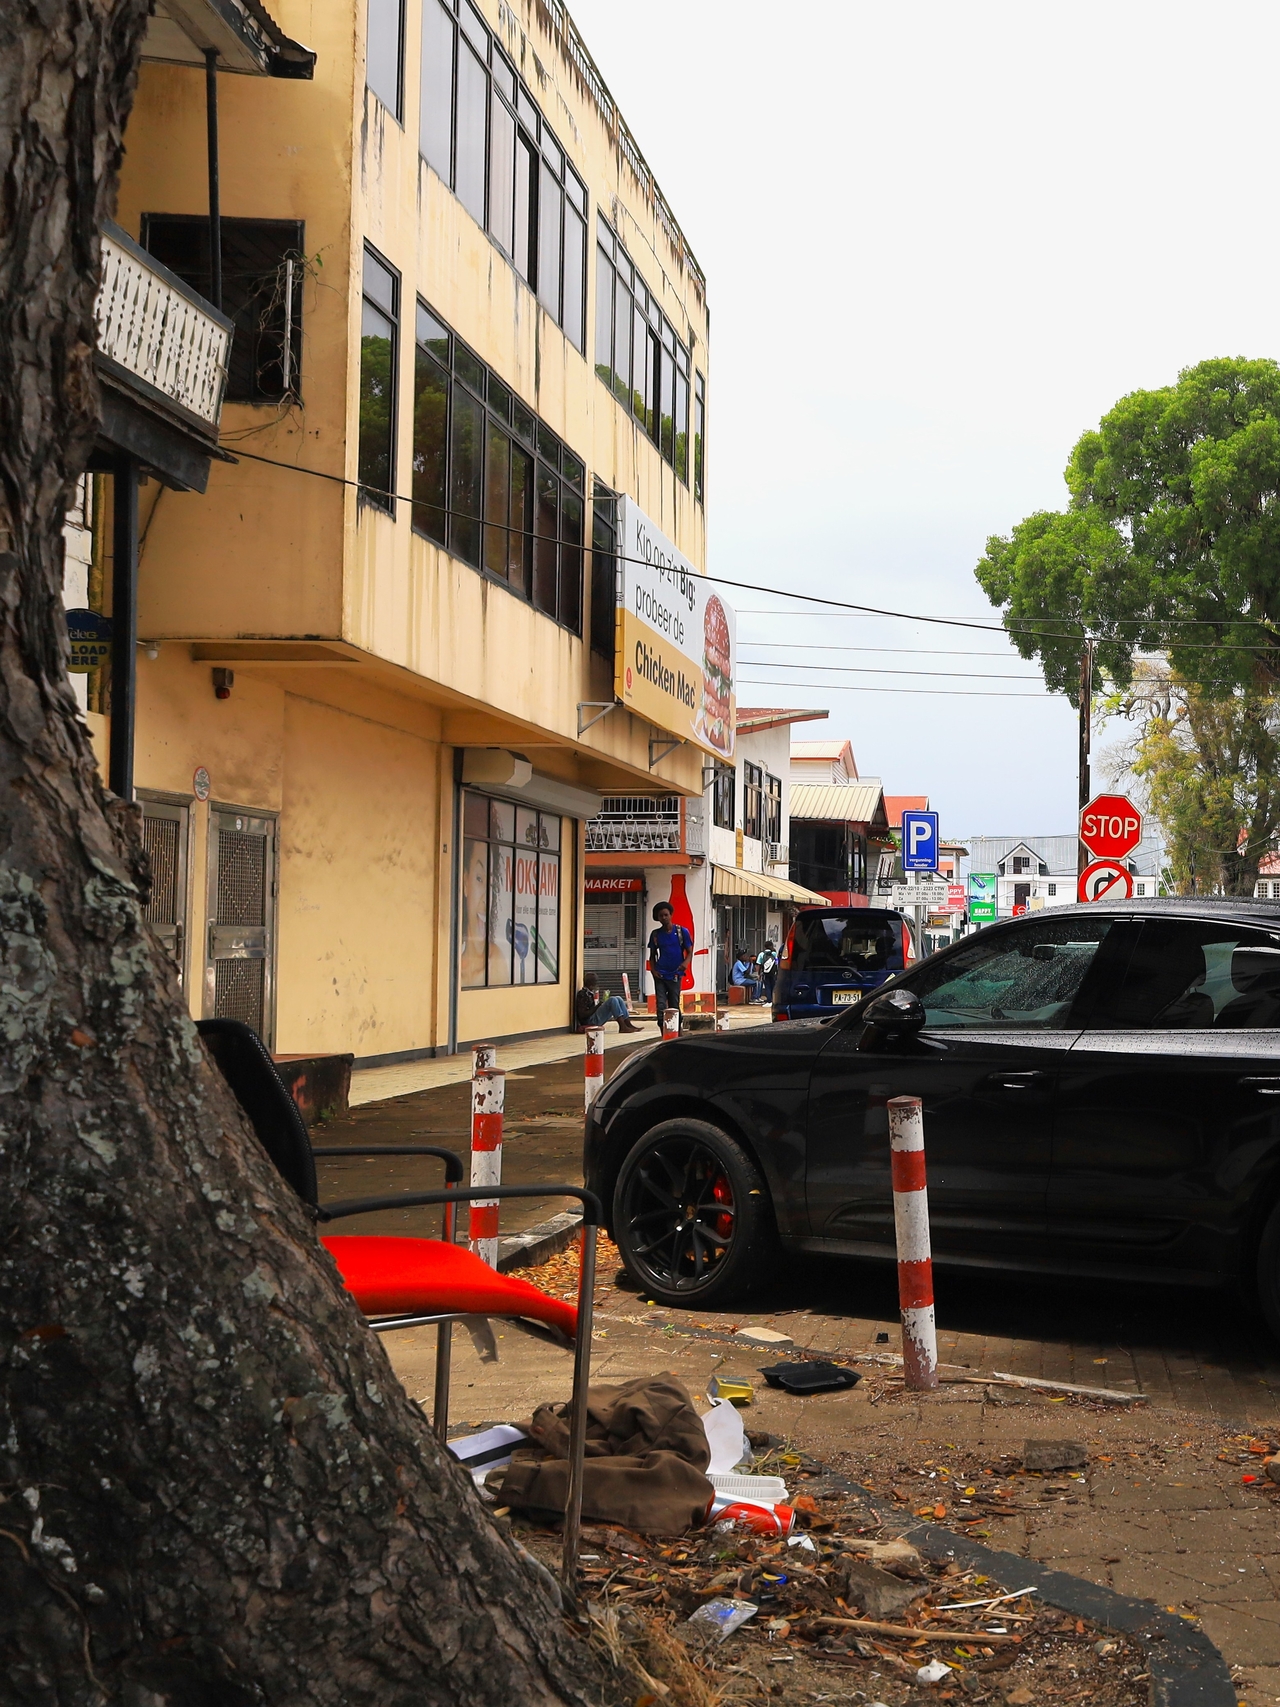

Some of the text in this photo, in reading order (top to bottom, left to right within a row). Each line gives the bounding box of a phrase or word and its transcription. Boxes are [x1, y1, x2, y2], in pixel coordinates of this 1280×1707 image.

[636, 519, 652, 570] Kip
[653, 544, 666, 584] op
[635, 583, 685, 645] probeer de
[635, 640, 696, 710] Chicken Mac
[910, 821, 932, 855] P
[1083, 814, 1139, 839] STOP
[584, 879, 633, 889] MARKET
[834, 993, 860, 1001] PA-73-51
